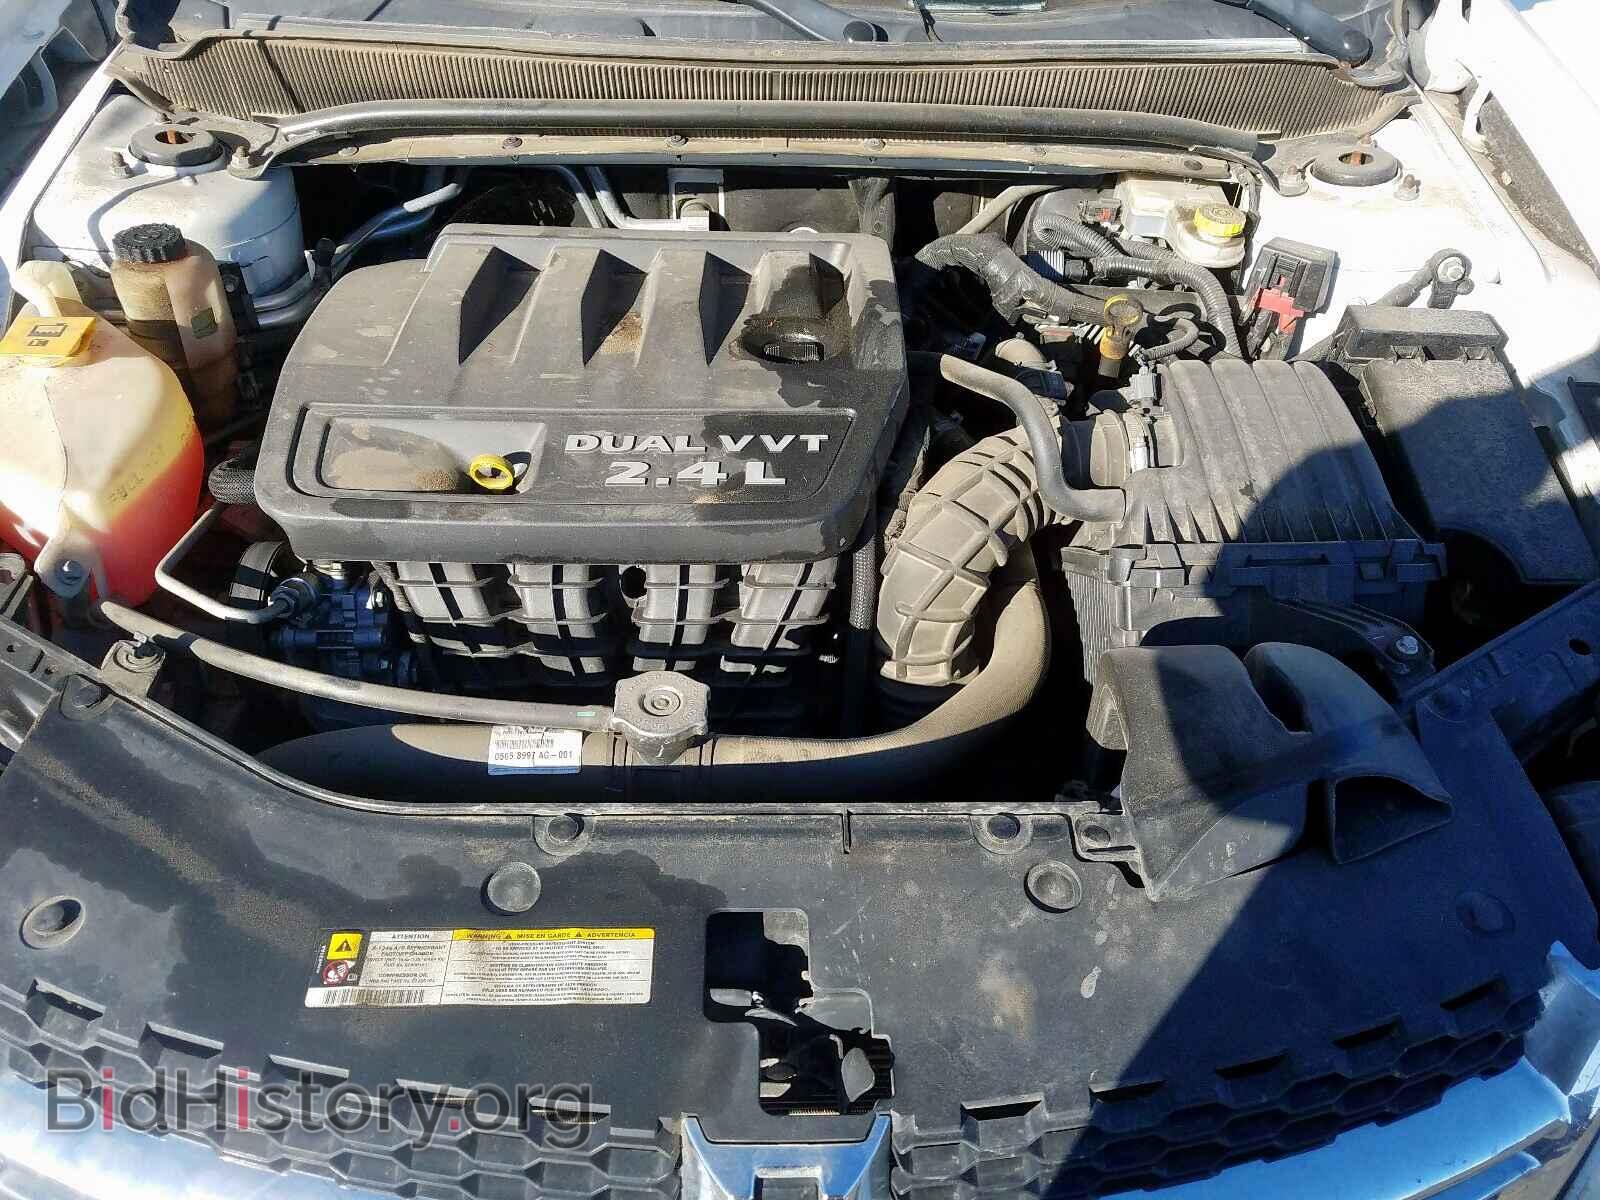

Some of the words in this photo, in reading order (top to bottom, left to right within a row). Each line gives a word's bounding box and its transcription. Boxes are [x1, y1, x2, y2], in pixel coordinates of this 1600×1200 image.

[564, 434, 707, 453] DUAL
[718, 434, 829, 453] VVT
[605, 461, 728, 486] 2.4
